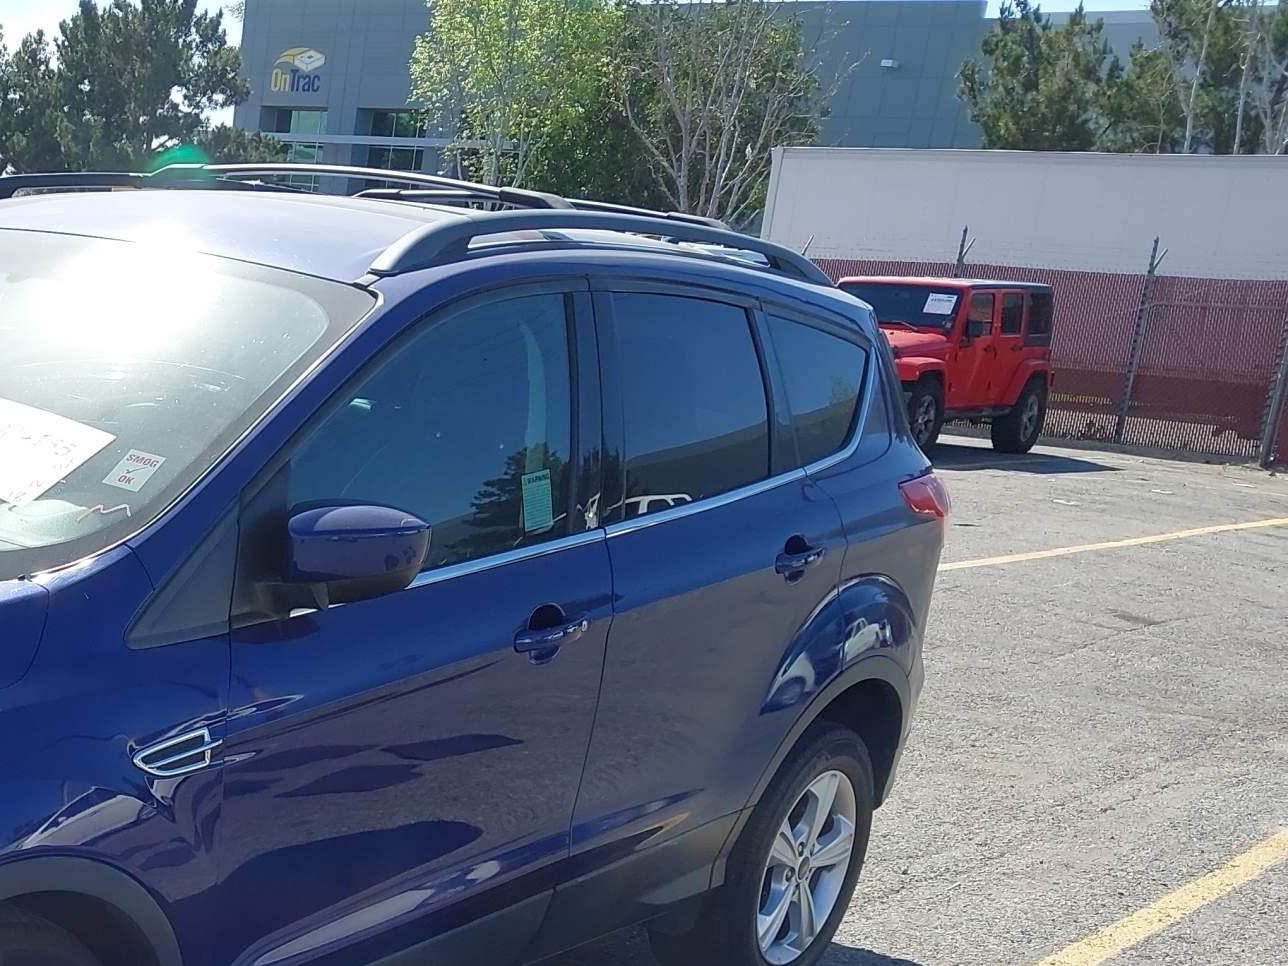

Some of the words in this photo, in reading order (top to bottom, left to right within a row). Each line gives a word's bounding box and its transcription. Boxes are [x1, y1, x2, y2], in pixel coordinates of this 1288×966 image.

[270, 68, 321, 93] OnTrac
[126, 453, 160, 468] SMOG
[117, 474, 135, 485] OK
